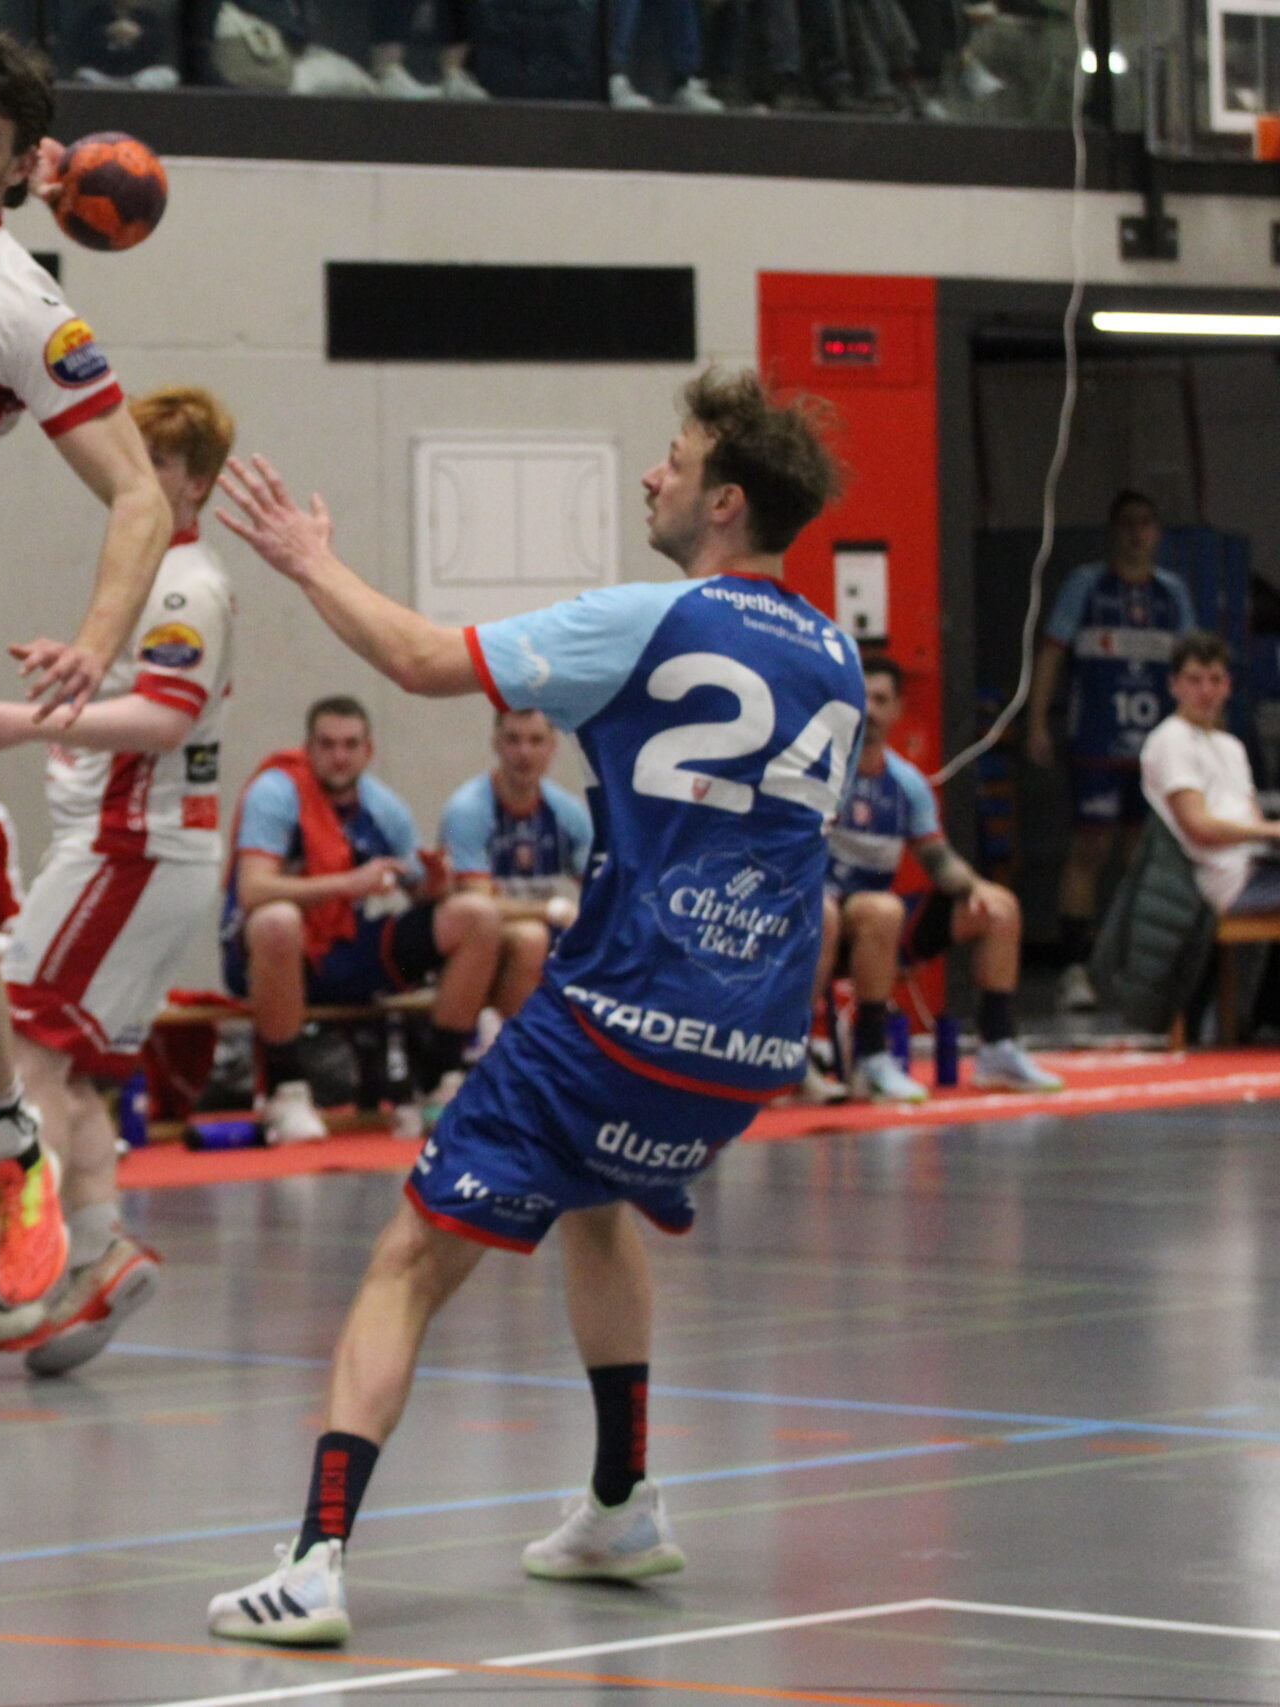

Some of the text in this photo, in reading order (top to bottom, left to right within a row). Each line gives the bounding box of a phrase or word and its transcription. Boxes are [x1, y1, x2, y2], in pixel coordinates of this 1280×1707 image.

[1113, 691, 1160, 728] 10
[632, 652, 862, 832] 24
[669, 883, 791, 936] Christen
[697, 920, 759, 962] Beck
[596, 1121, 707, 1170] dusch
